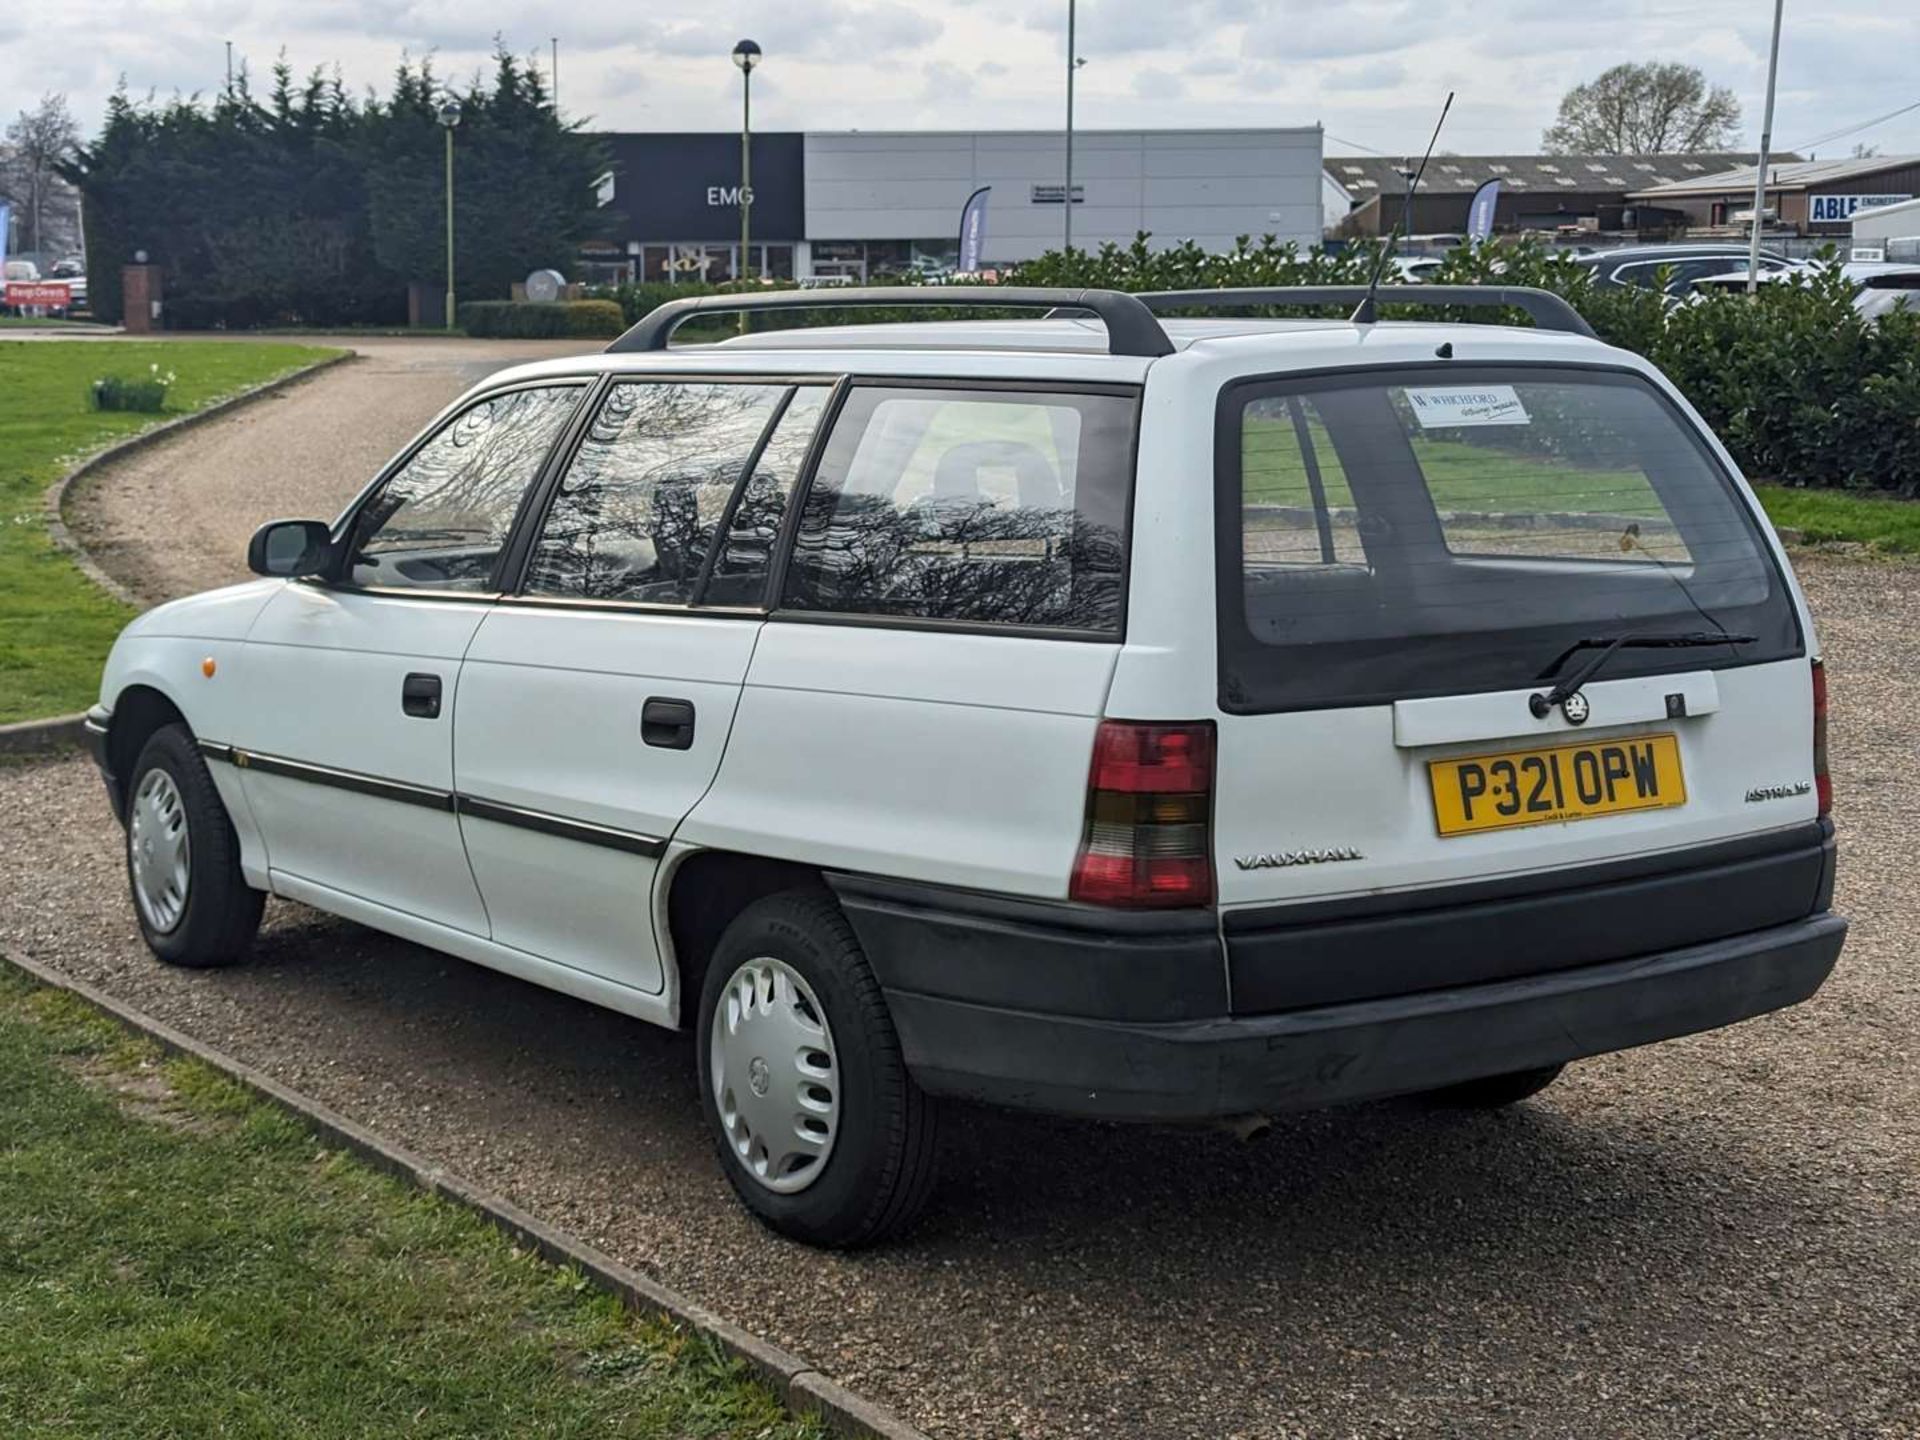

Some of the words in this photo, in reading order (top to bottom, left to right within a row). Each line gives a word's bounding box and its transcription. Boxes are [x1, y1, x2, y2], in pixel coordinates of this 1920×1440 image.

[708, 186, 754, 205] EMG
[1813, 197, 1858, 220] ABLE
[1430, 394, 1498, 405] WHICHFORD
[1457, 754, 1565, 821] P321
[1573, 743, 1659, 806] OPW
[1744, 785, 1793, 803] ASTRA
[1233, 846, 1366, 870] VAUXHALL
